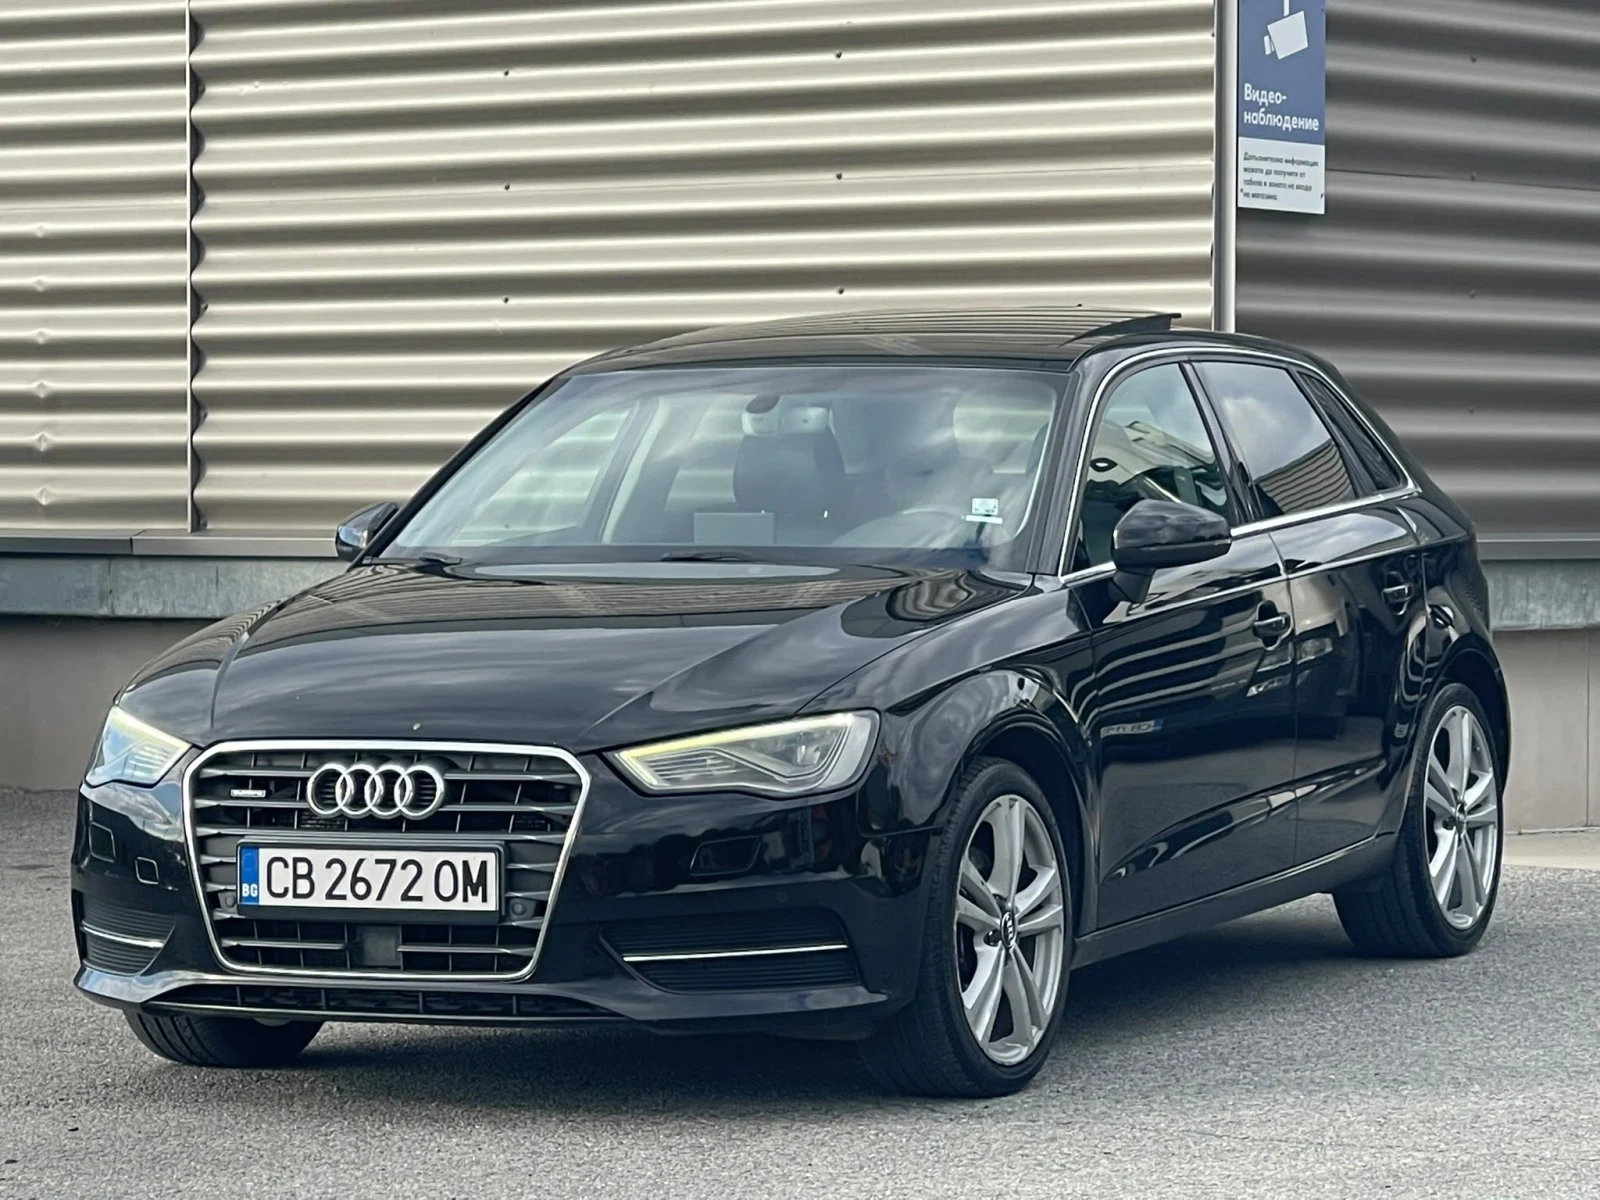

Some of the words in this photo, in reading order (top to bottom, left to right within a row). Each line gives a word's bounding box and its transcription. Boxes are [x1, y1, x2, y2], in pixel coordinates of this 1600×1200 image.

[1244, 83, 1287, 107] Видео-
[1244, 107, 1320, 132] наблюдение
[241, 882, 258, 898] BG
[266, 856, 316, 899] CB
[324, 857, 424, 903] 2672
[433, 859, 488, 904] OM
